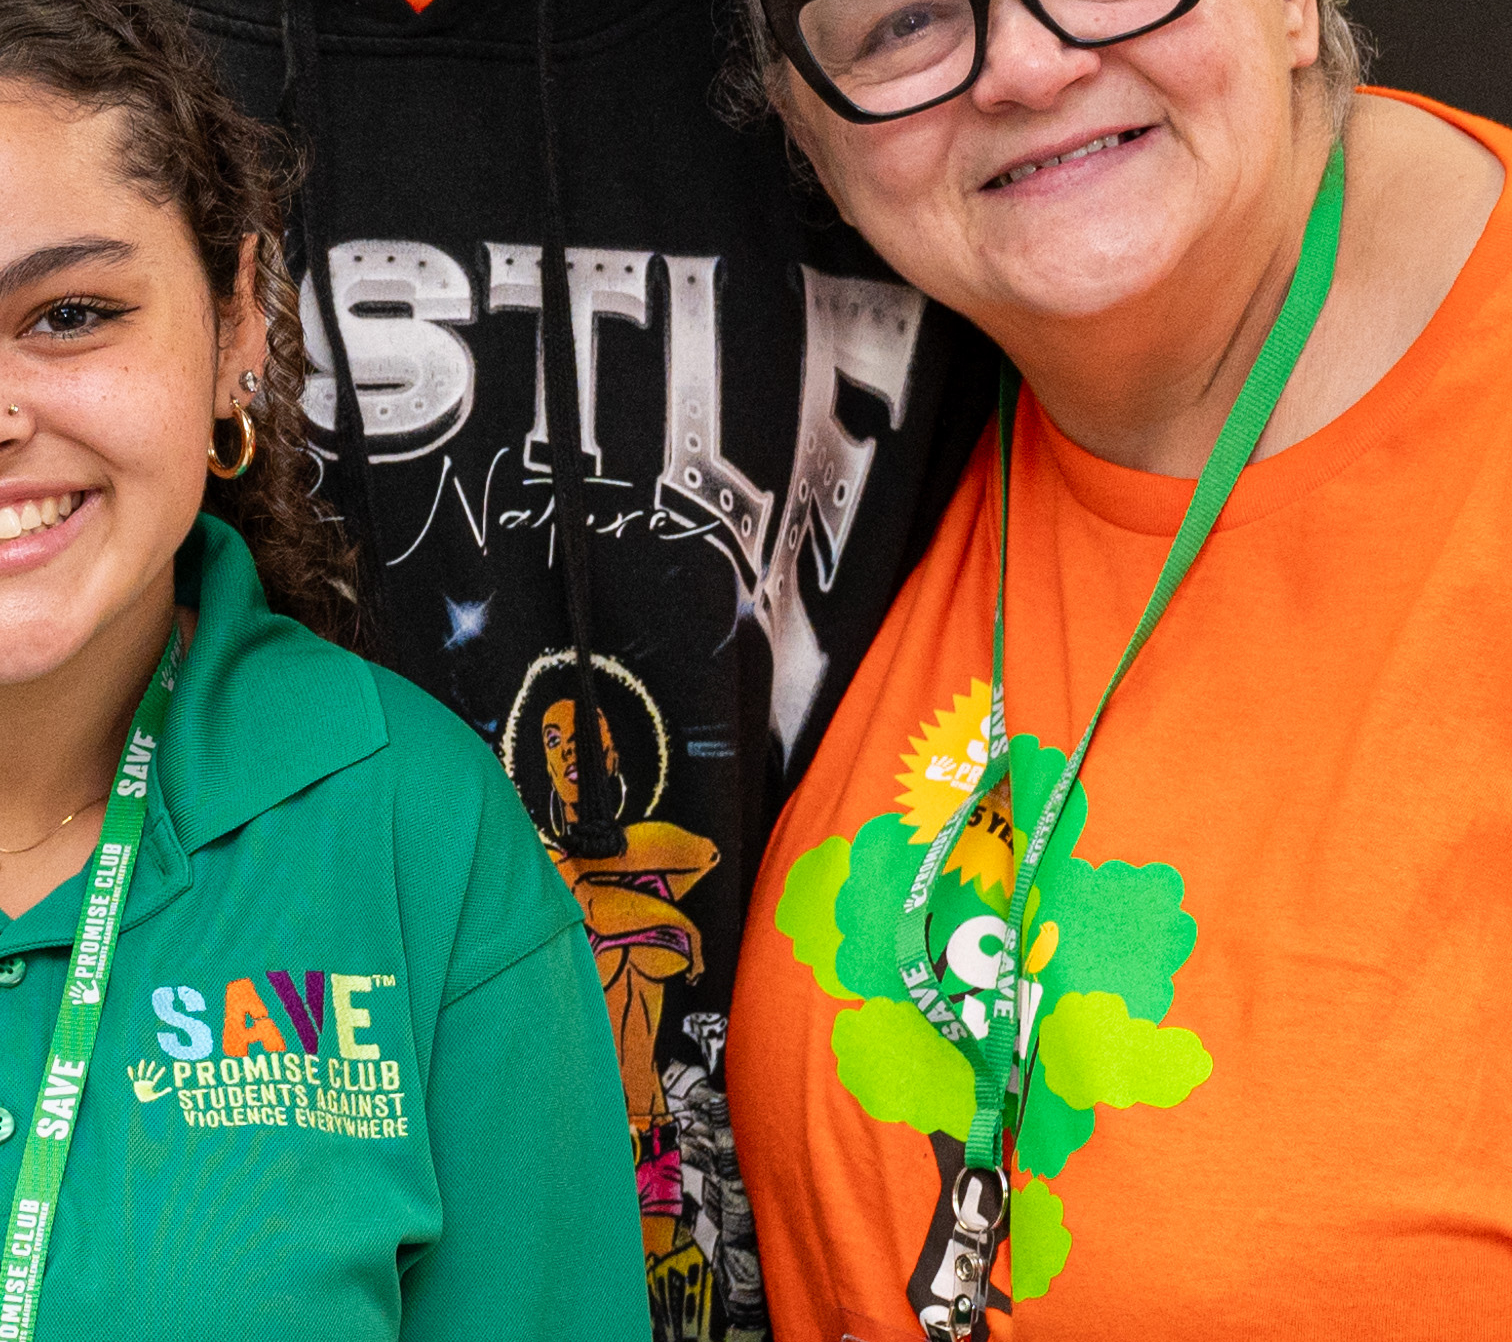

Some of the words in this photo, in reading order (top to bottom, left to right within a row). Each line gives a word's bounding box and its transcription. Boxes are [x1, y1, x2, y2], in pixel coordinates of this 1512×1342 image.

[117, 726, 158, 798] SAVE
[74, 893, 111, 979] PROMISE
[94, 841, 123, 888] CLUB
[900, 960, 968, 1042] SAVE
[993, 927, 1017, 1018] SAVE
[151, 970, 381, 1061] SAVE
[35, 1054, 86, 1141] SAVE
[173, 1053, 321, 1088] PROMISE
[328, 1059, 401, 1091] CLUB
[177, 1083, 309, 1111] STUDENTS
[316, 1088, 405, 1118] AGAINST
[183, 1107, 288, 1128] VIOLENCE
[295, 1108, 409, 1139] EVERYWHERE
[11, 1198, 40, 1257] CLUB
